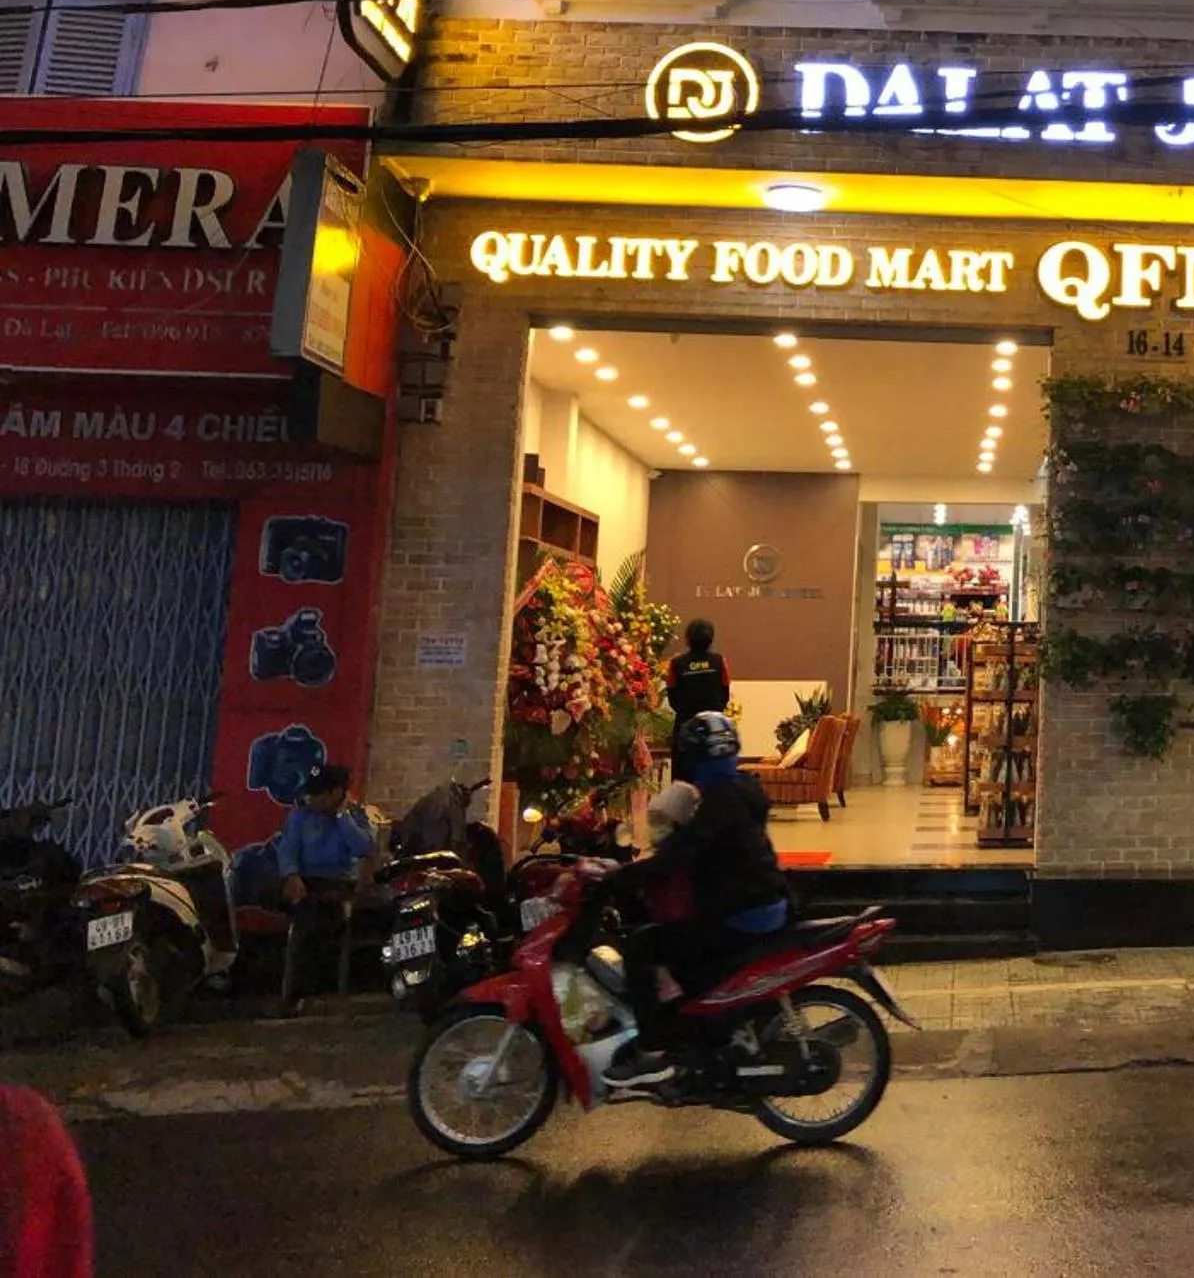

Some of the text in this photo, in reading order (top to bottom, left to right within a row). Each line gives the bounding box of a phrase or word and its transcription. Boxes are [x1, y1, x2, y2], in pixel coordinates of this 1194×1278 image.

[470, 230, 698, 284] QUALITY
[710, 240, 855, 287] FOOD
[866, 246, 1015, 292] MART
[73, 404, 156, 442] MÀU
[163, 415, 186, 441] 4
